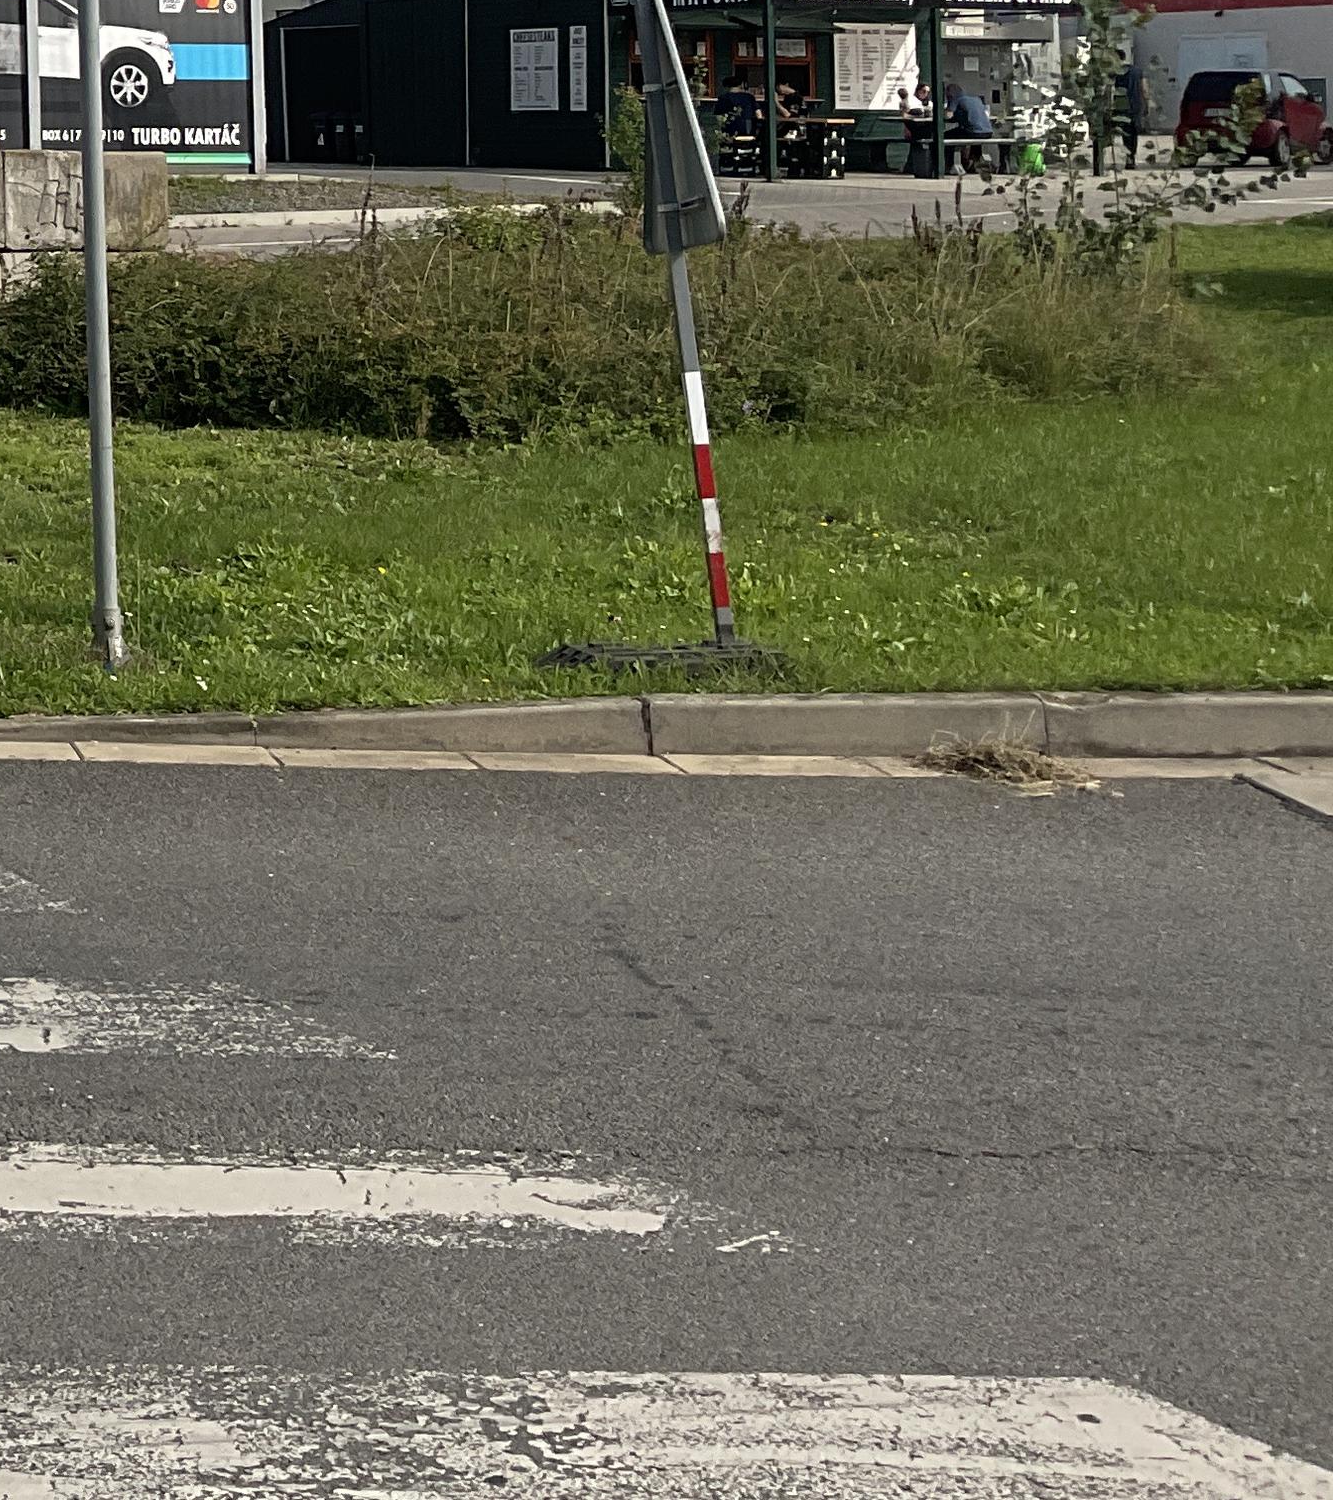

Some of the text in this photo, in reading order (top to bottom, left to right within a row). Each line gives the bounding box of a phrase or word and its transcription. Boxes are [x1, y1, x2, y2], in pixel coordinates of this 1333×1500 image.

[42, 129, 61, 141] BOX
[131, 123, 241, 145] TURBO KARTÁČ
